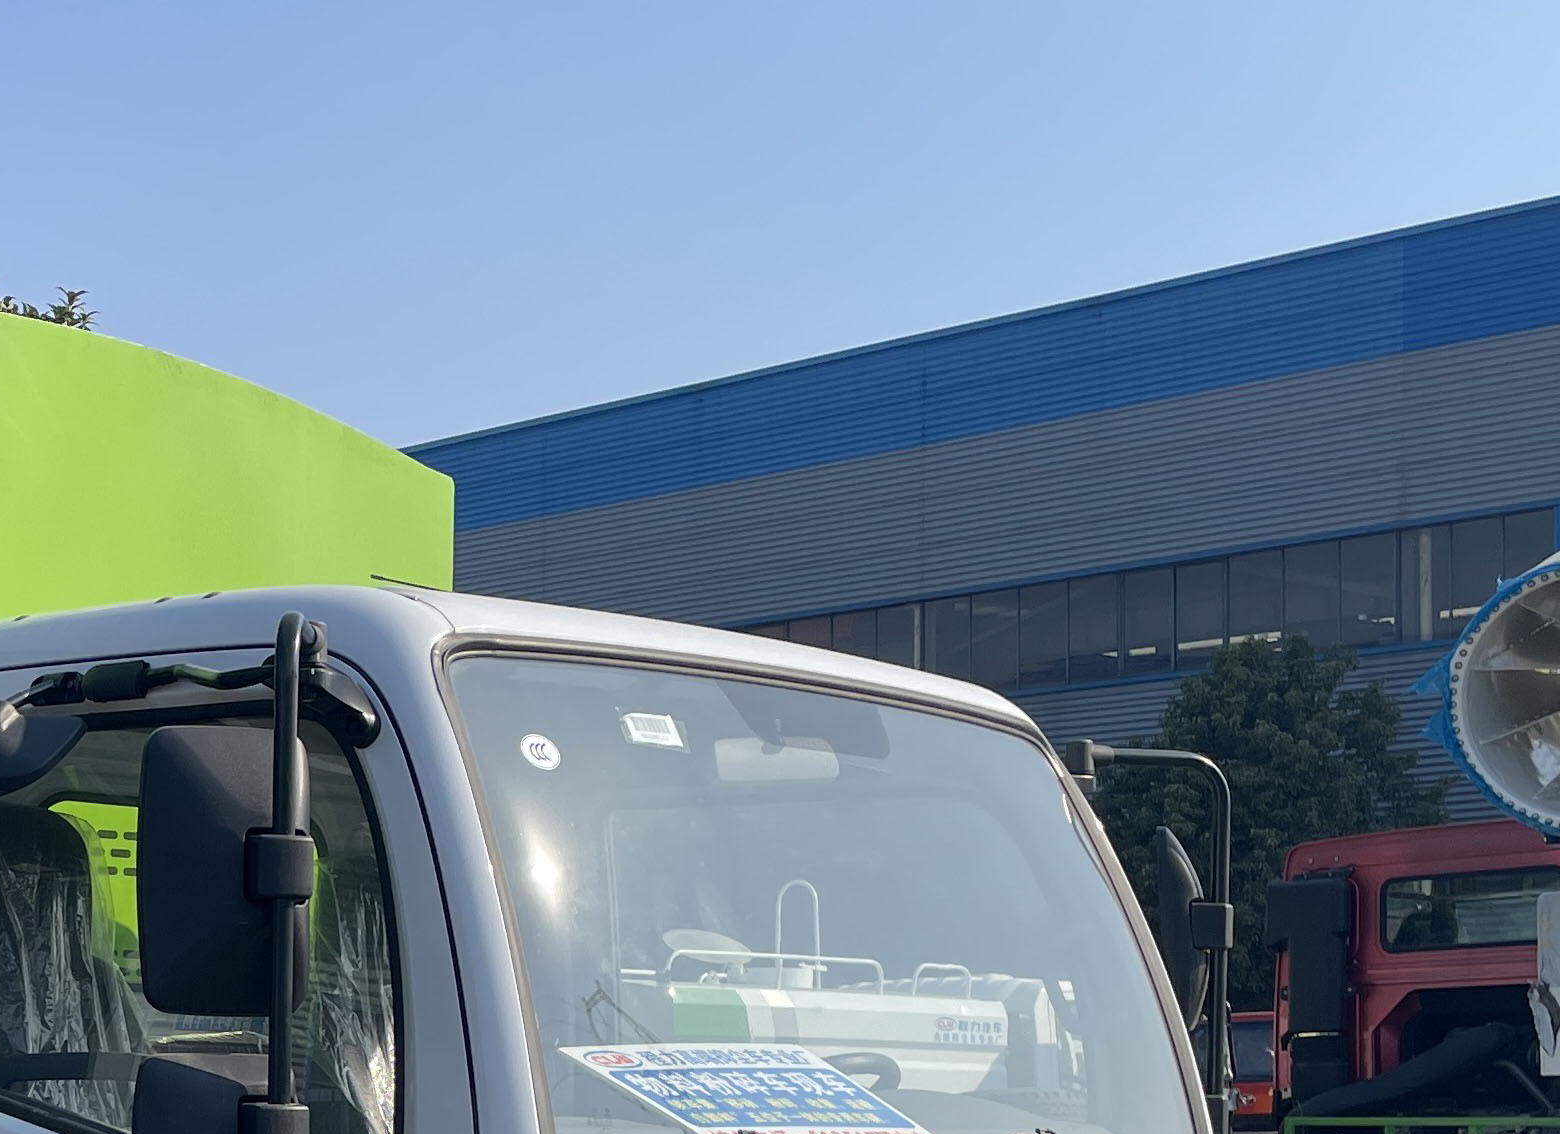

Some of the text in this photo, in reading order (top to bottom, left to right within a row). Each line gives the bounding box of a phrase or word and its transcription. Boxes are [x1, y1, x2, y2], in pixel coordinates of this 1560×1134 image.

[625, 1071, 859, 1099] 物料粉碎车现车
